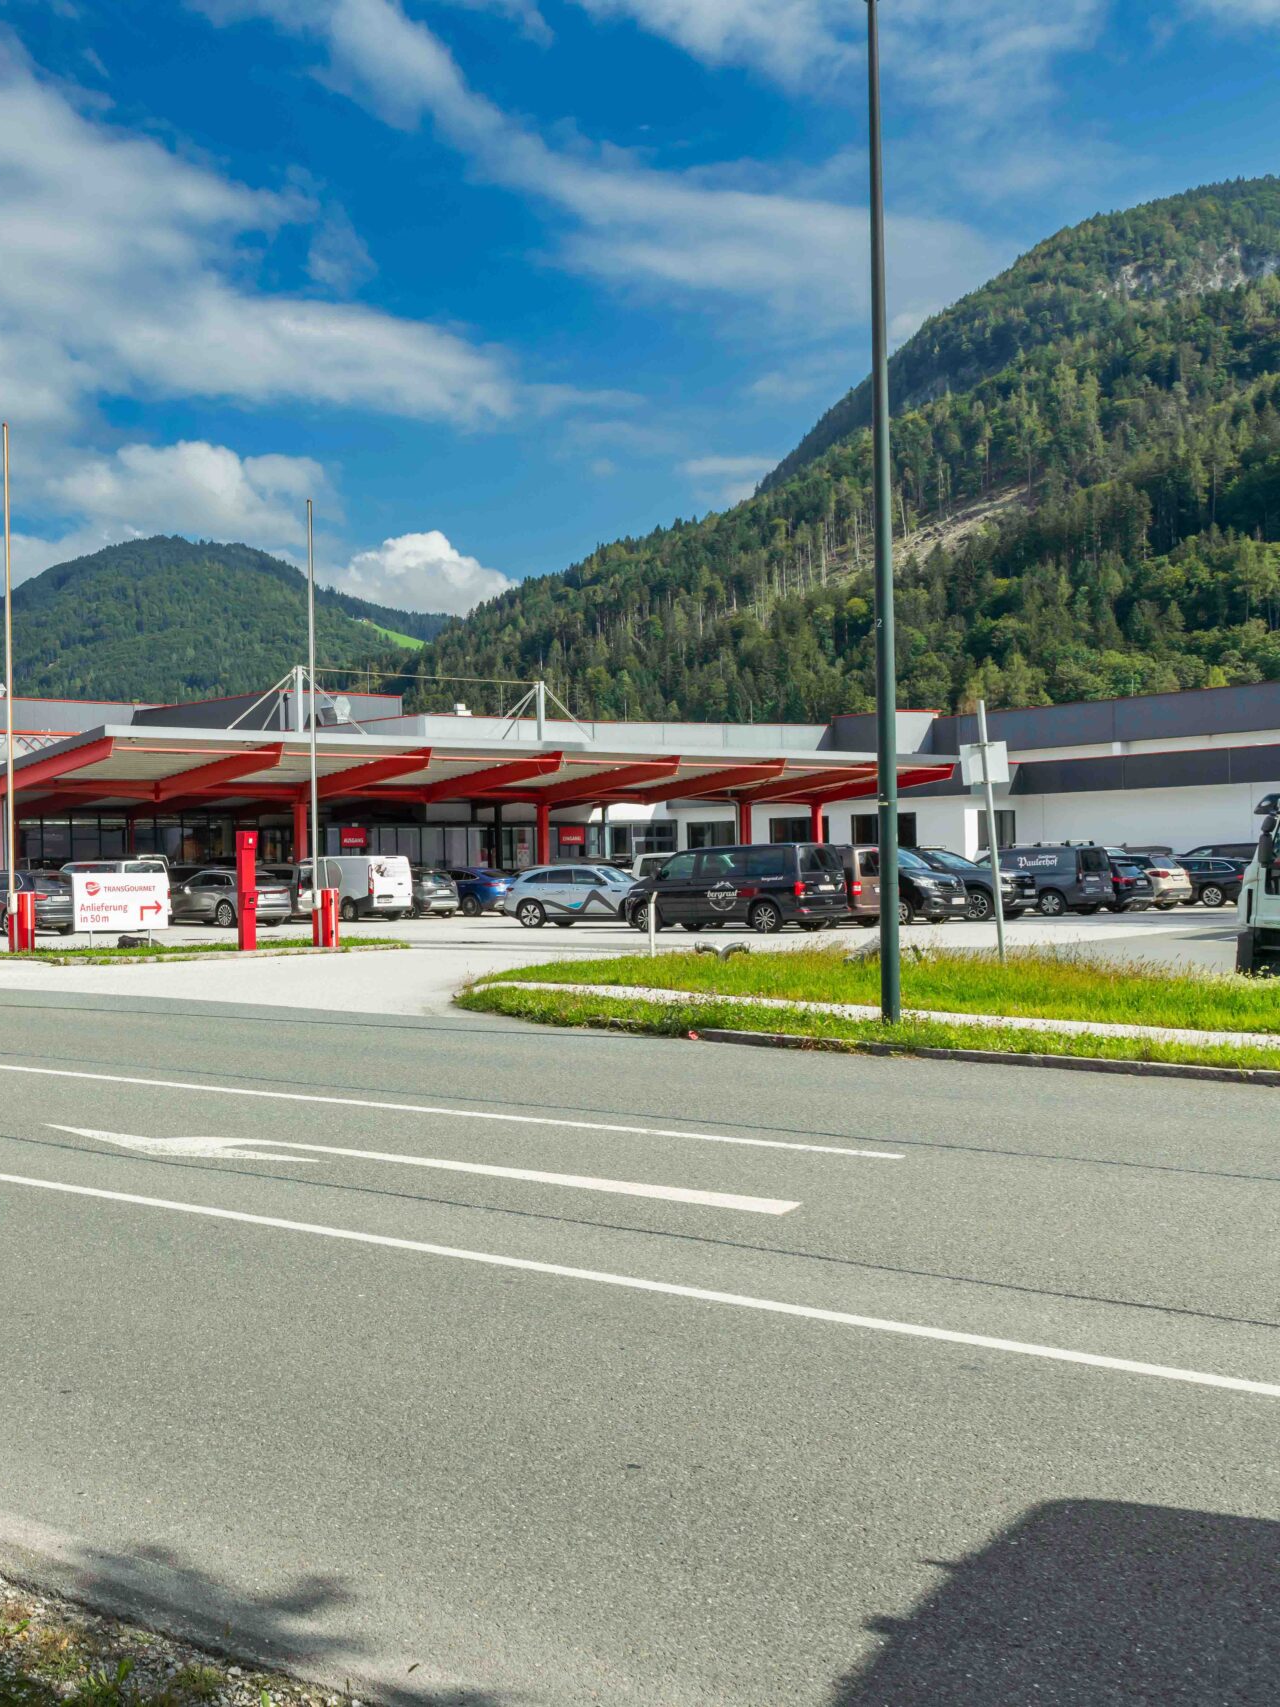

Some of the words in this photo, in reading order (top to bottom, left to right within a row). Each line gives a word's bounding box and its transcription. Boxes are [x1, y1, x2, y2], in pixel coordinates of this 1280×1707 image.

[1017, 857, 1058, 868] Paulerhof
[706, 889, 739, 899] bergrast
[80, 903, 128, 913] Anlieferung
[80, 915, 88, 923] in
